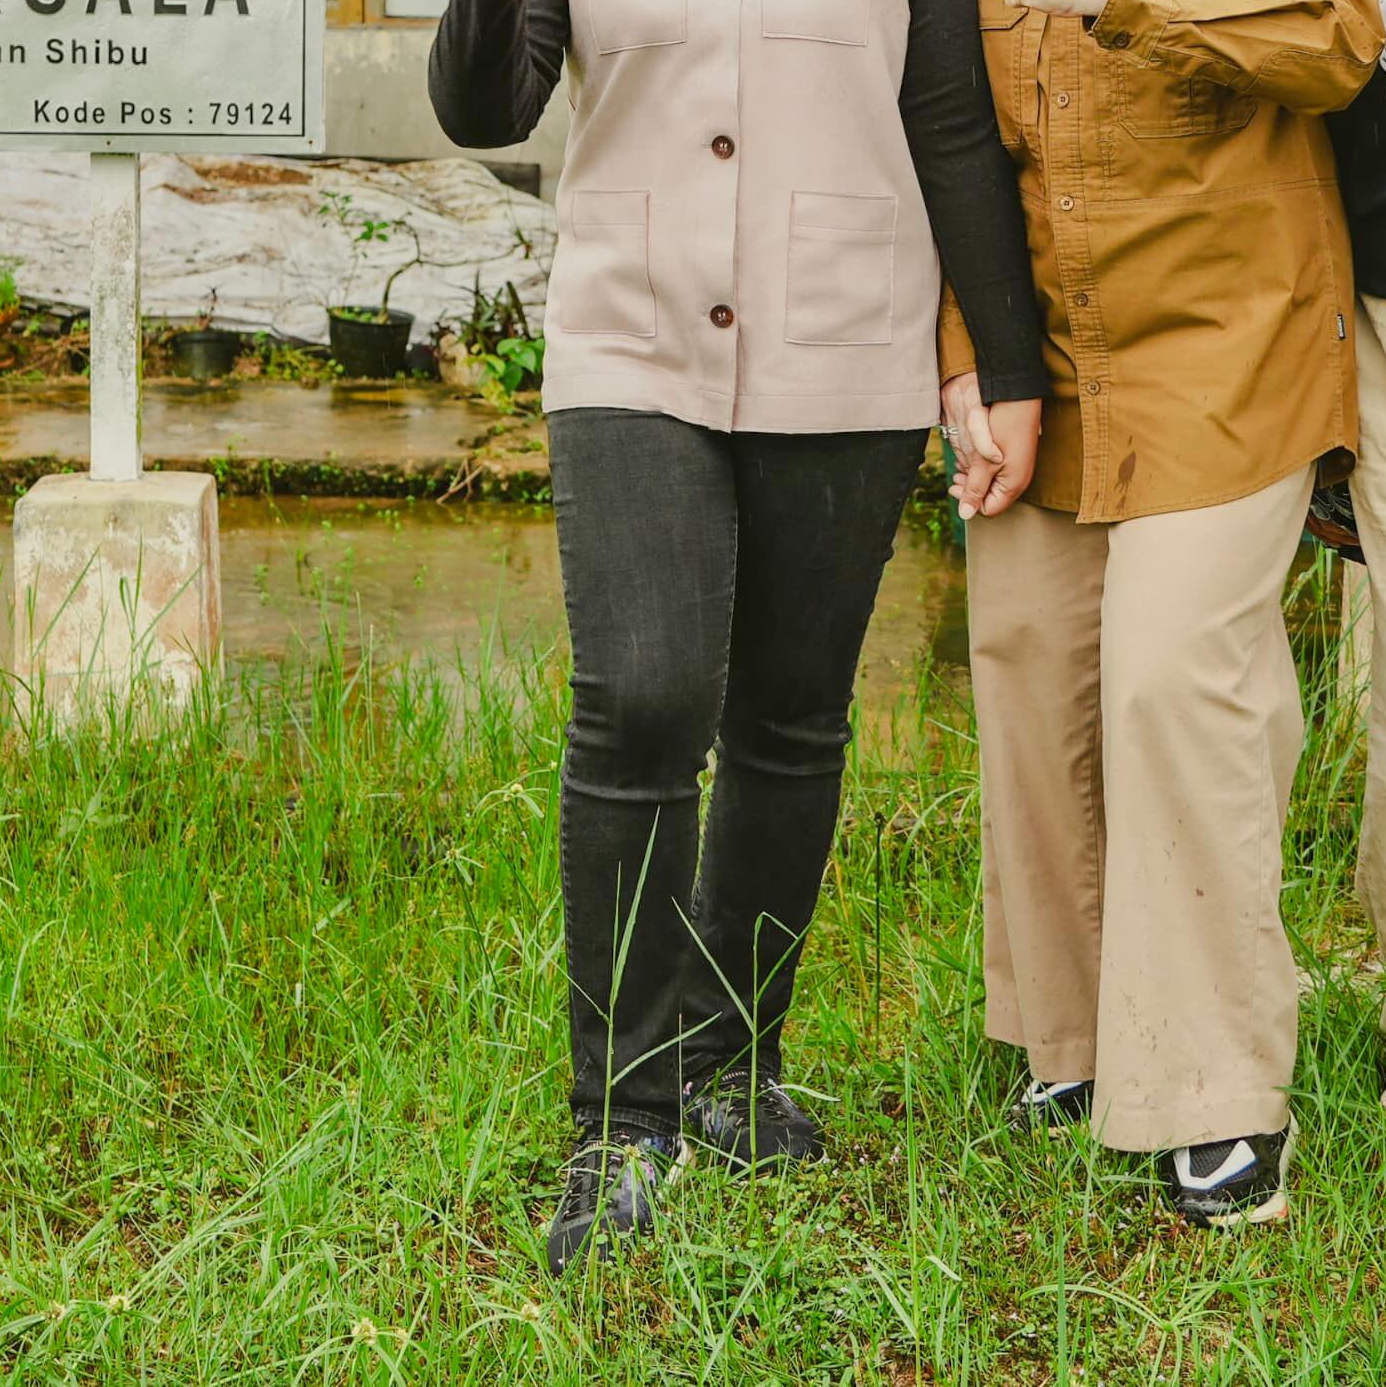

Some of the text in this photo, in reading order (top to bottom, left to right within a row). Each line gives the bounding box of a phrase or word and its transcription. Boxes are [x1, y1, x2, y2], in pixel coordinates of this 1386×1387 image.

[45, 38, 148, 67] Shibu
[34, 99, 106, 124] Kode
[120, 101, 172, 125] Pos
[208, 101, 293, 126] 79124
